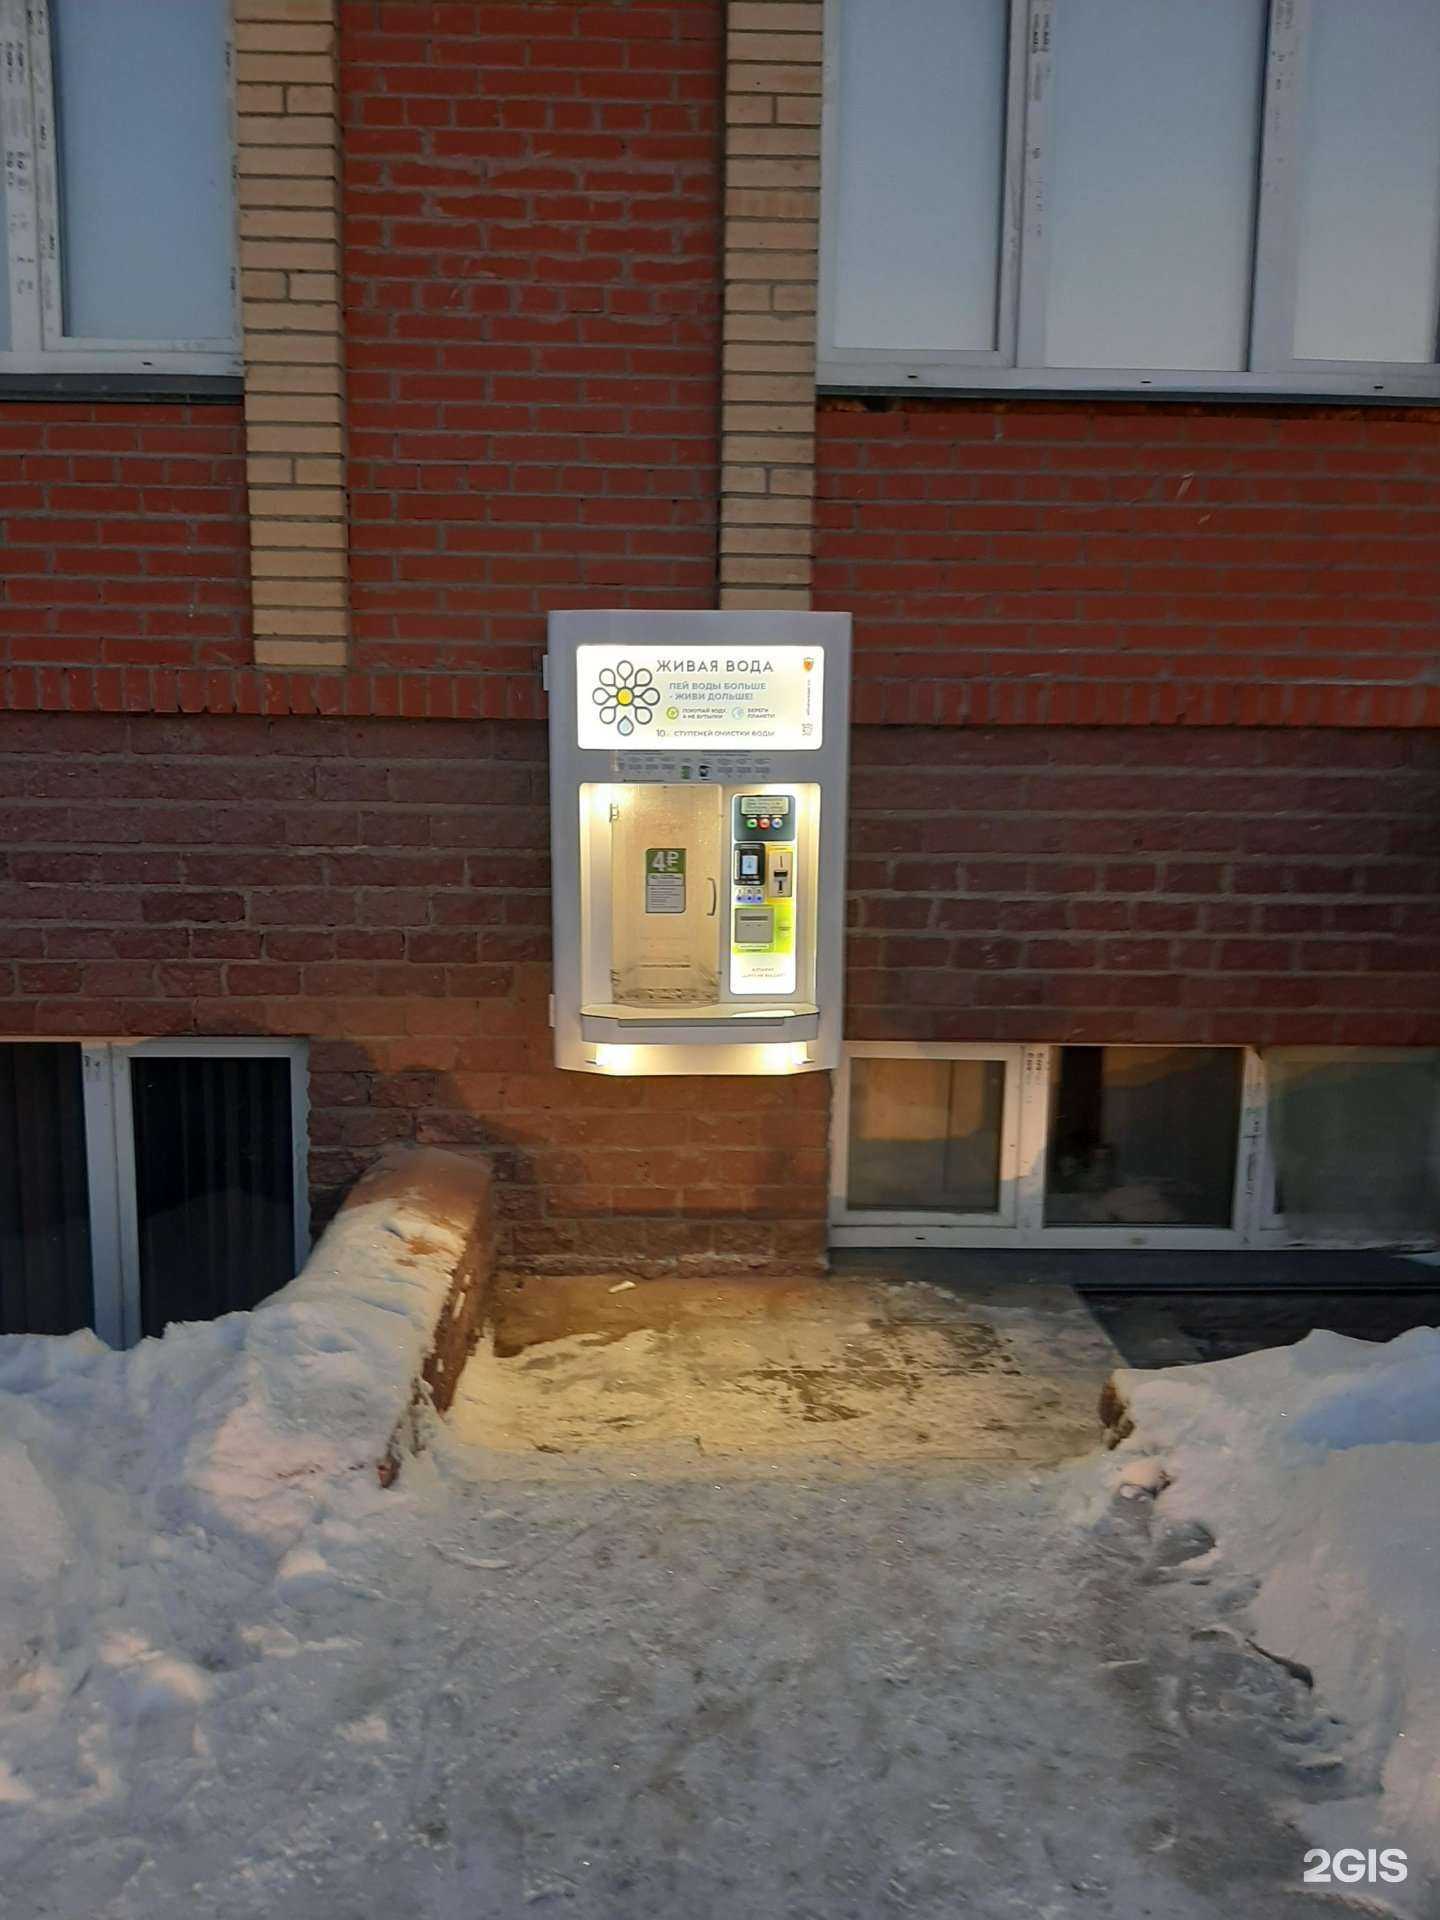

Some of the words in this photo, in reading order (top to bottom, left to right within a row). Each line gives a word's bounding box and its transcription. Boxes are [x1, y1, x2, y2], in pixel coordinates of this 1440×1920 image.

[656, 660, 718, 673] ЖИВАЯ
[726, 660, 774, 674] ВОДА
[669, 681, 689, 690] ПЕЙ
[692, 682, 721, 691] ВОДЫ
[725, 682, 767, 690] БОЛЬШЕ
[675, 692, 705, 701] ЖИВИ
[674, 729, 714, 737] СТУПЕНЕЙ
